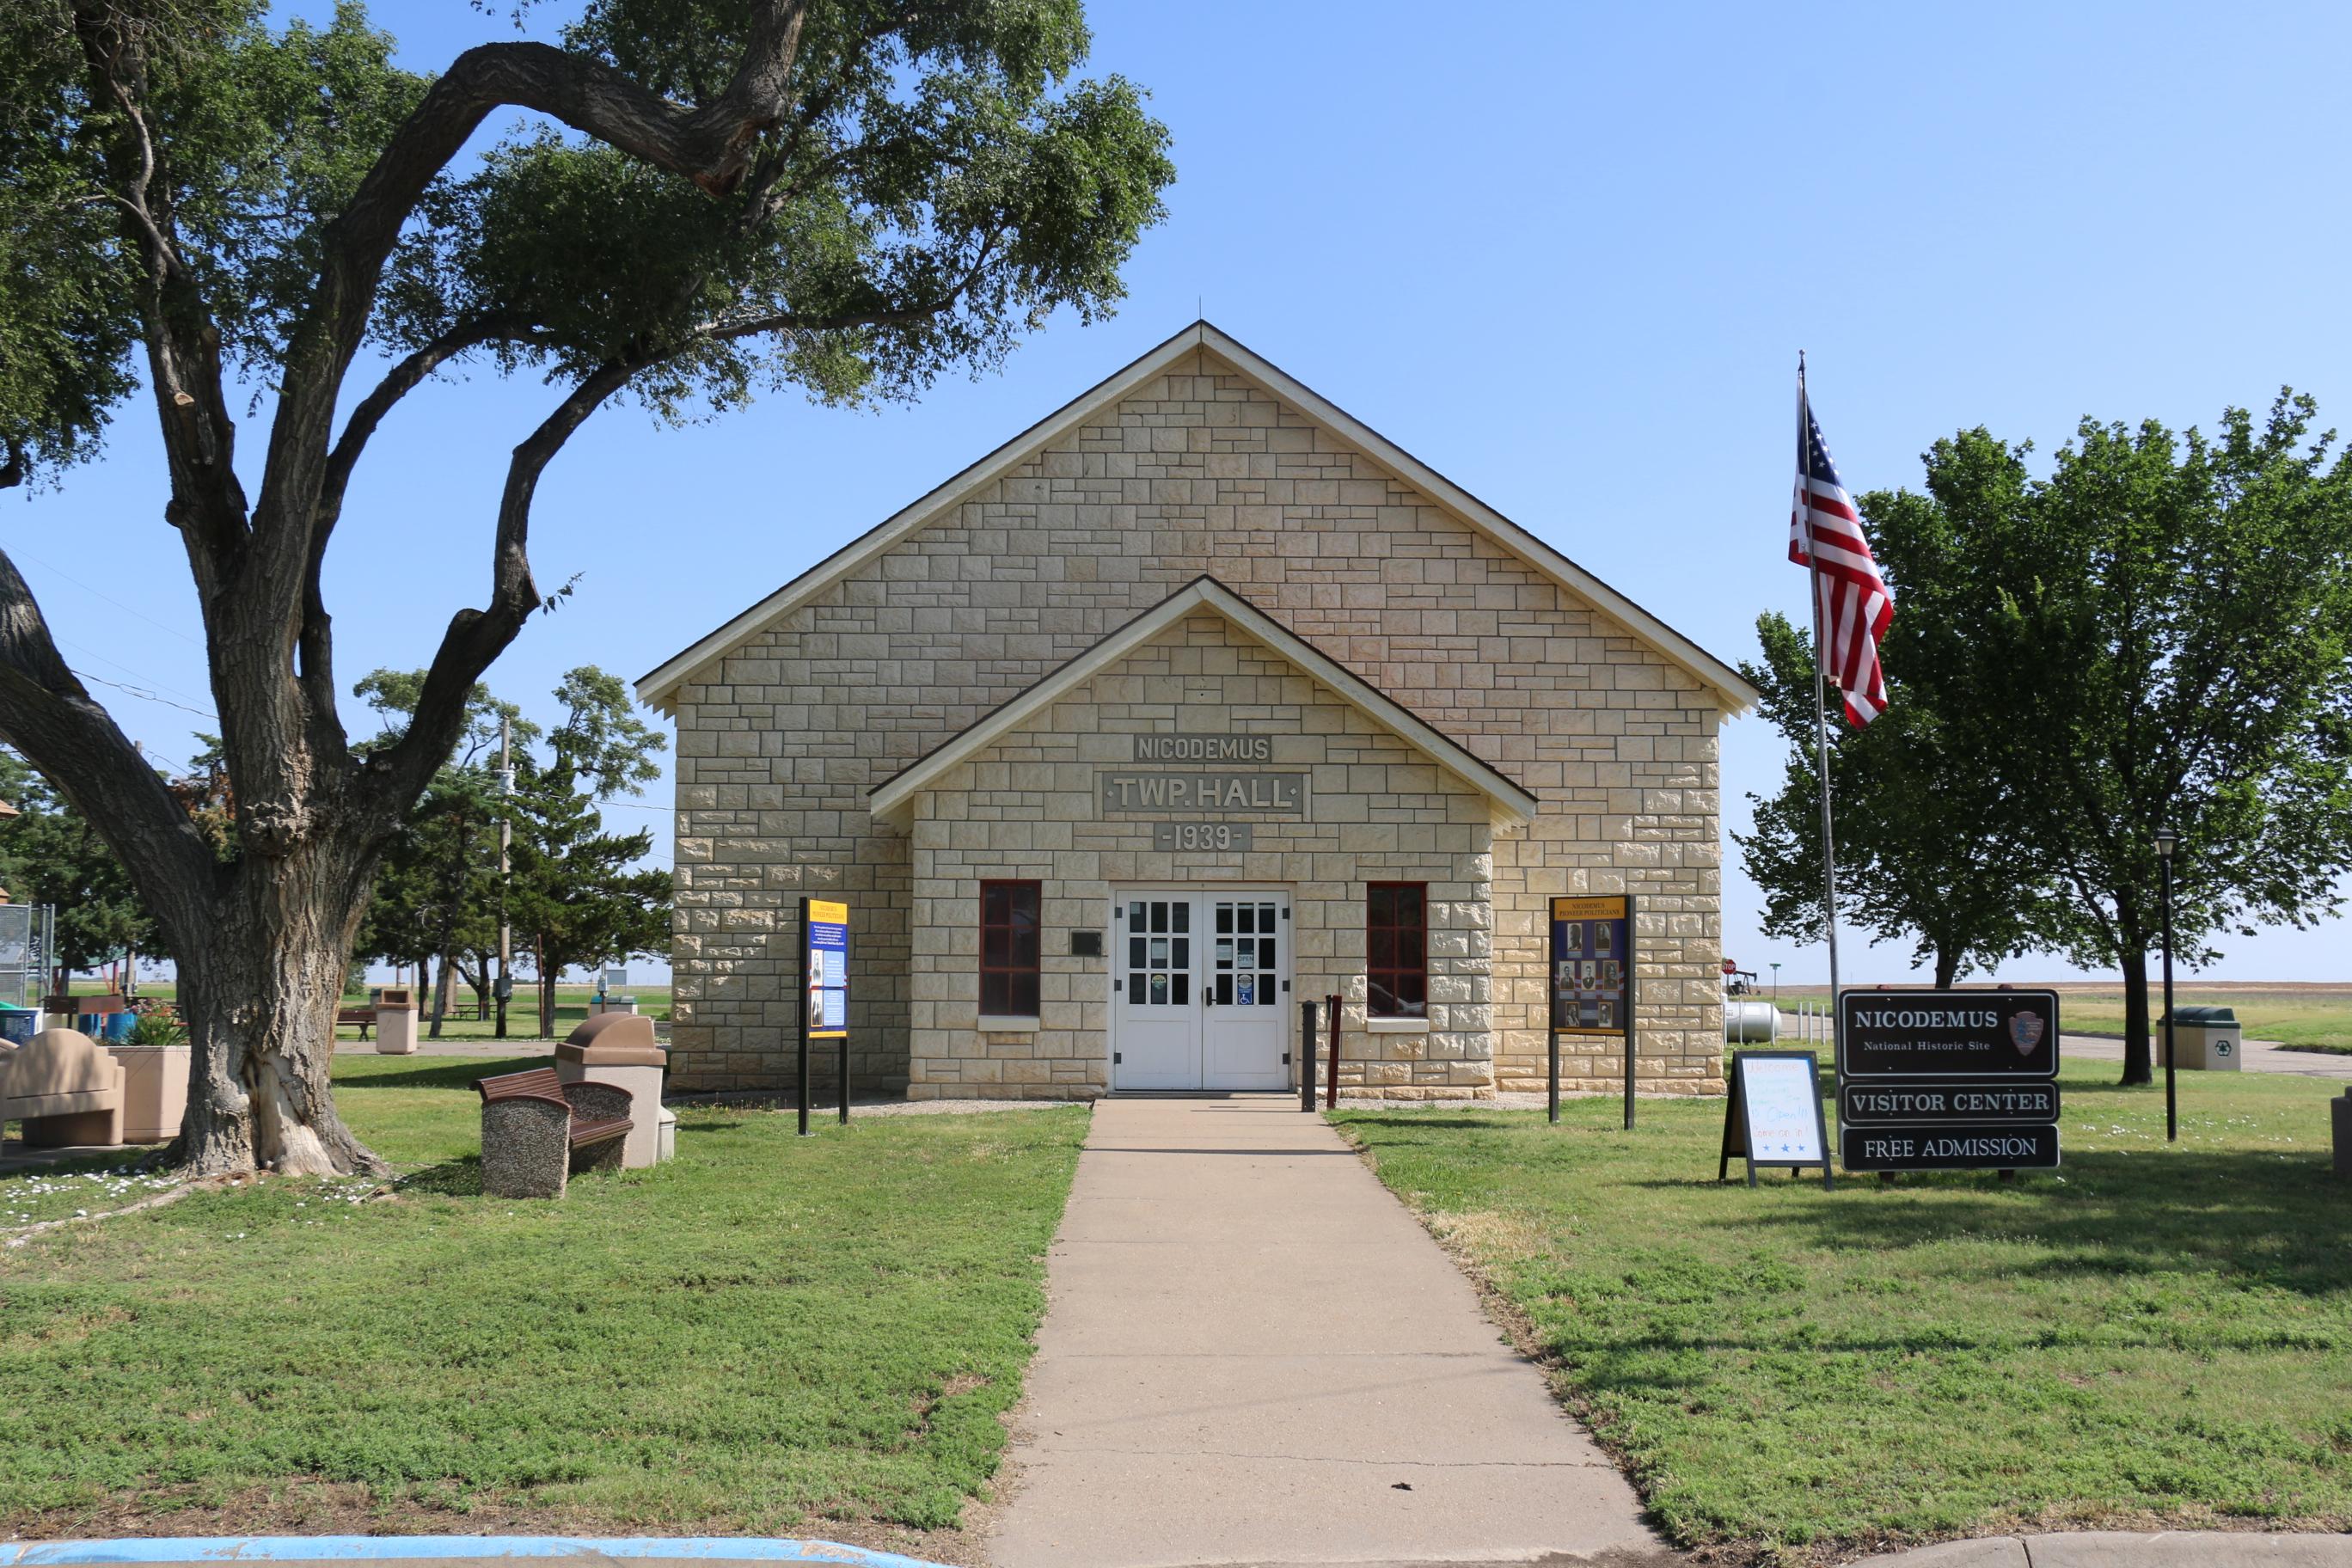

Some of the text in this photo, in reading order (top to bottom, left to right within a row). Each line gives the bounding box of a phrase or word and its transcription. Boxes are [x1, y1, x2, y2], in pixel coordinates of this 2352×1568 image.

[1137, 738, 1269, 760] NICODEMUS
[1112, 778, 1293, 807] TWP. HALL
[1854, 1010, 1999, 1028] NICODEMUS
[1863, 1041, 1991, 1050] National Historic Site
[1852, 1093, 2049, 1112] VISITOR CENTER
[1864, 1137, 2037, 1158] FREE ADMISSION
